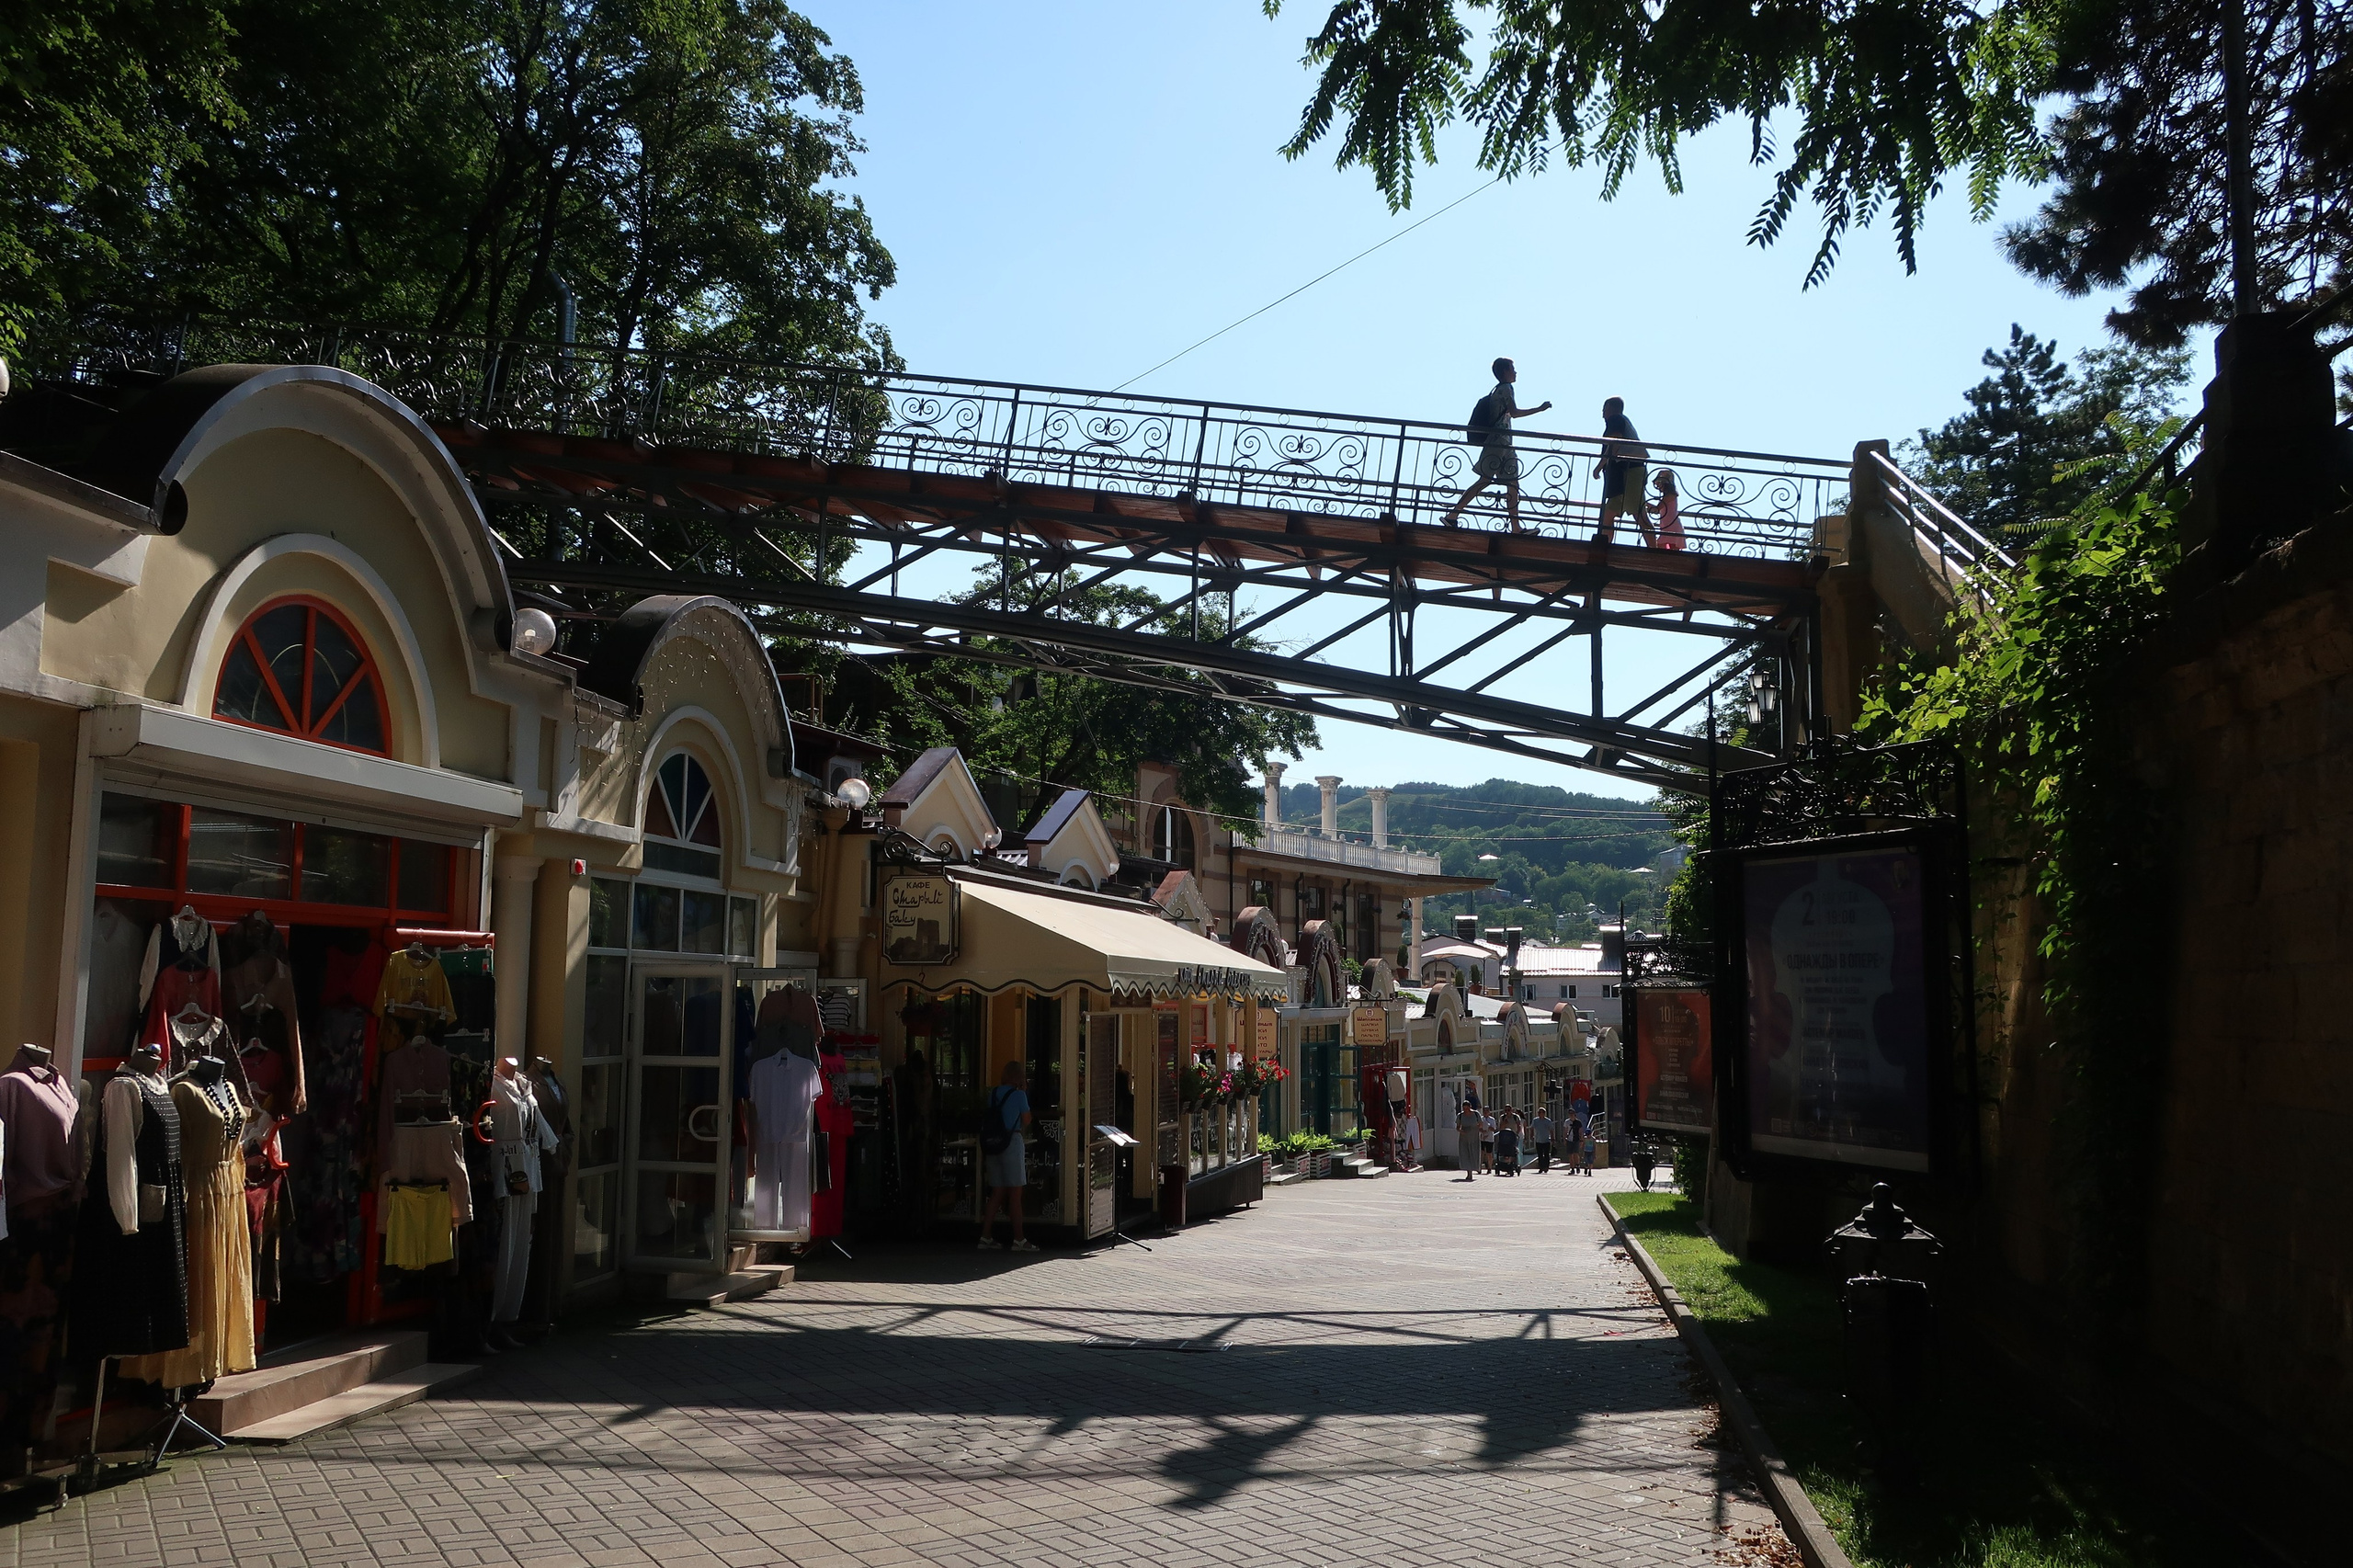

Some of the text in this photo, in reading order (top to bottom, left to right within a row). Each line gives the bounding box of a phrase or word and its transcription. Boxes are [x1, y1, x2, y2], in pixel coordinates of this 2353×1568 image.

[892, 888, 943, 908] Старый
[1802, 891, 1814, 926] 2
[889, 909, 915, 926] Баку
[1839, 953, 1847, 969] В
[1659, 1006, 1670, 1022] 10
